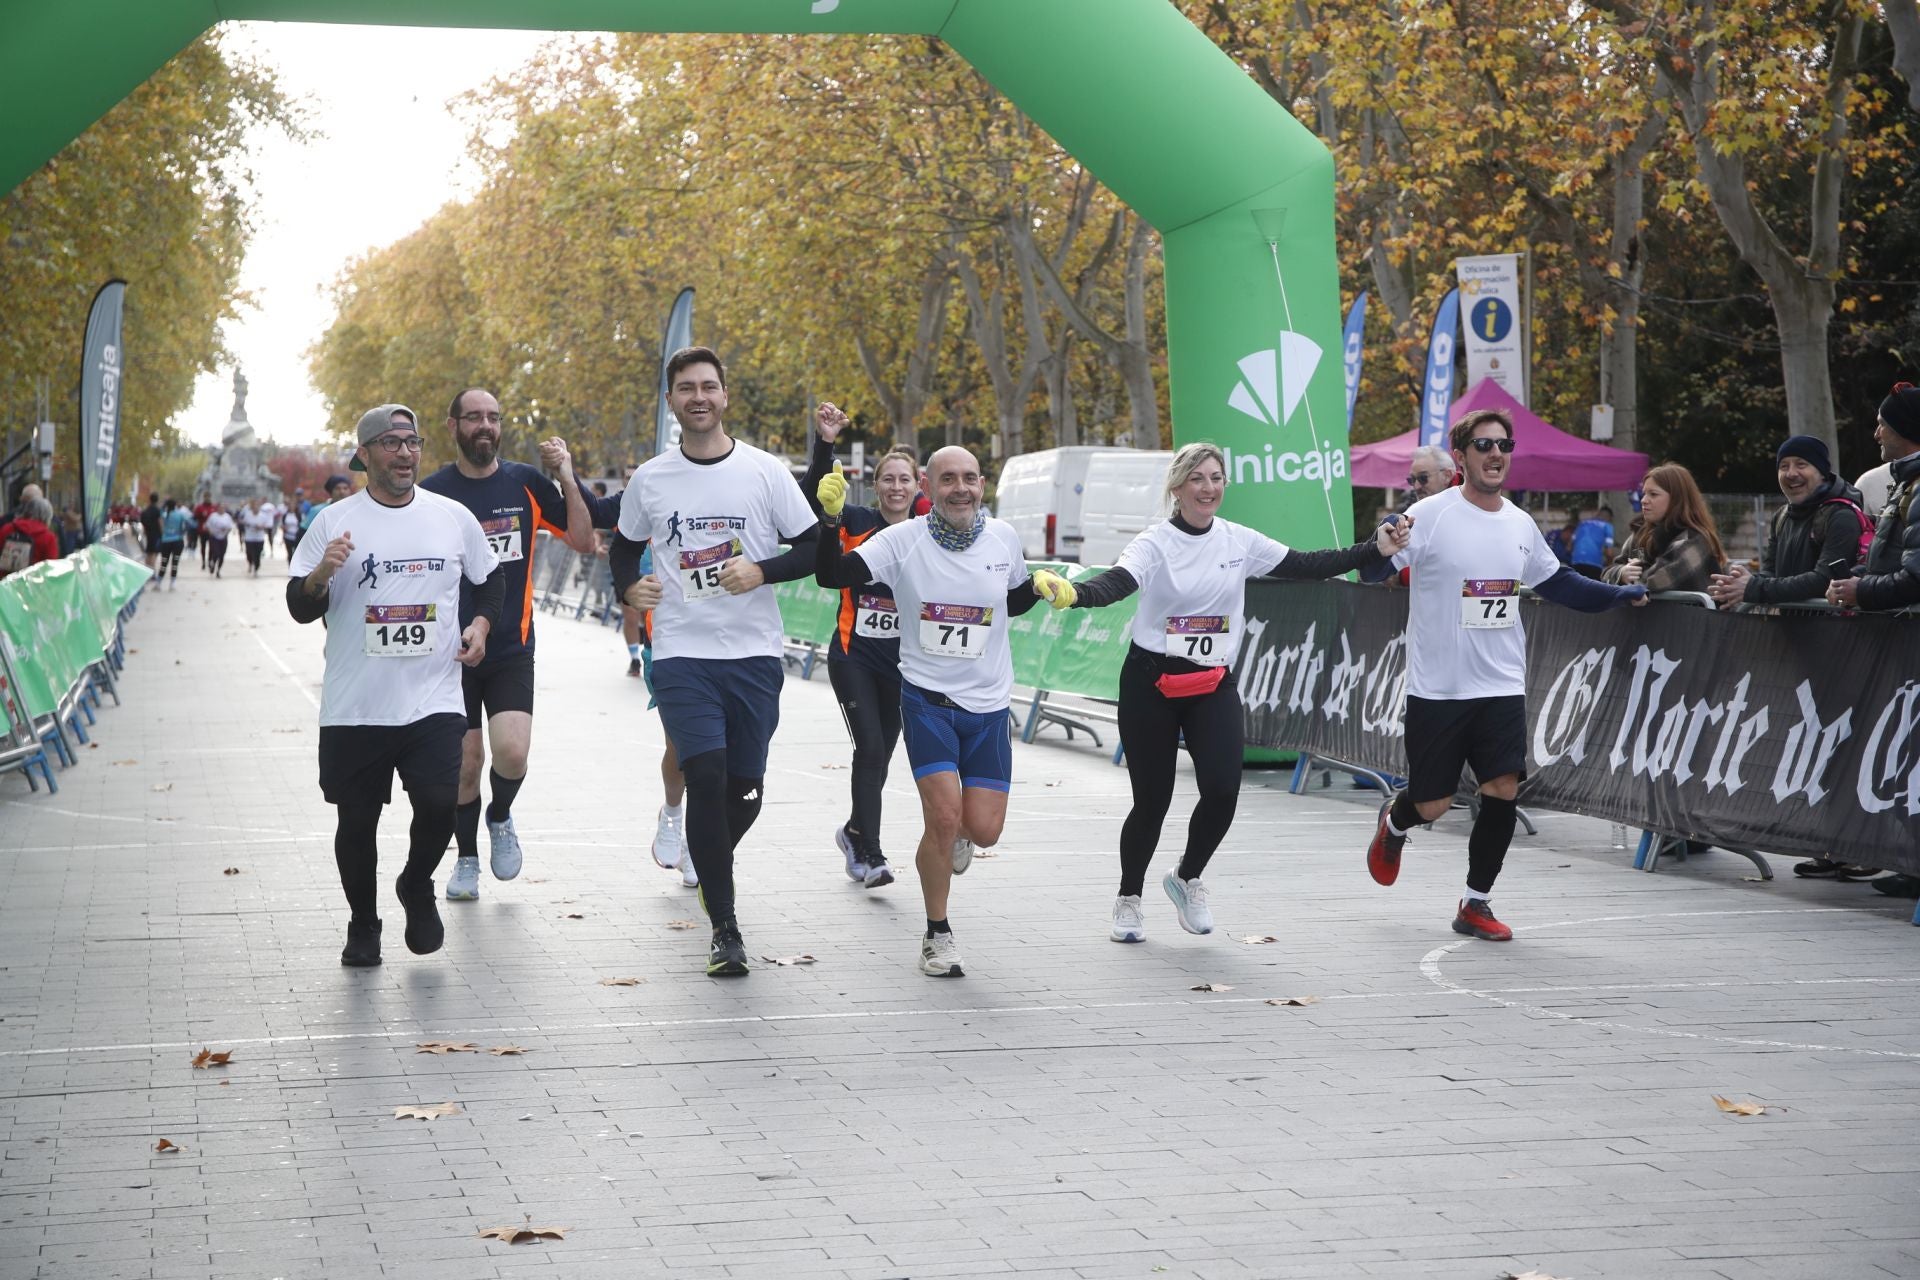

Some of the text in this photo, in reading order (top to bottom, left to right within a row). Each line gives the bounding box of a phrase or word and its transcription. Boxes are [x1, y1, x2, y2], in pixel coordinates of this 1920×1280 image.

[96, 343, 120, 467] Unicaja
[1481, 599, 1507, 618] 72
[376, 624, 426, 646] 149
[938, 625, 969, 648] 71
[1184, 636, 1212, 656] 70
[1609, 644, 1770, 797] Norte
[1770, 678, 1853, 807] de
